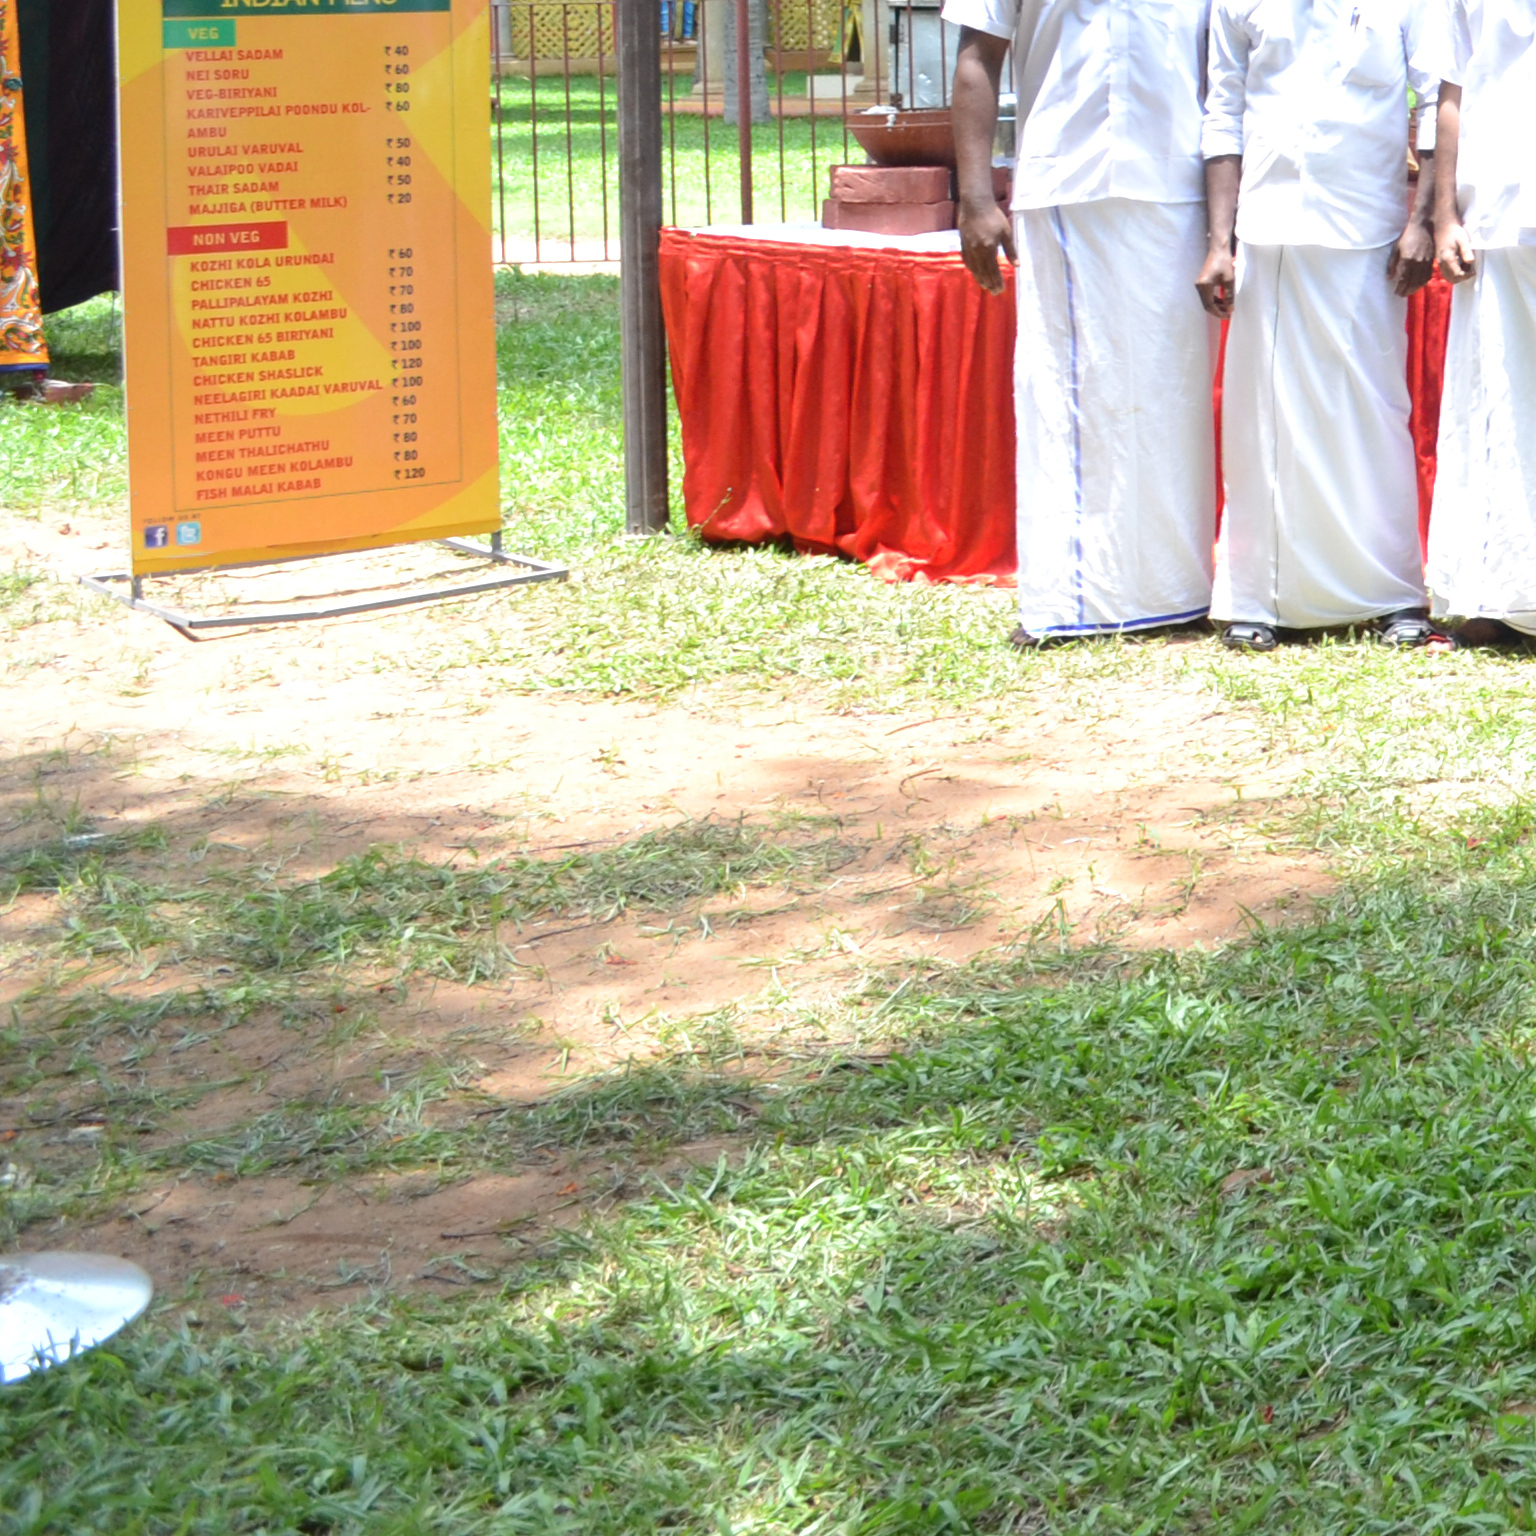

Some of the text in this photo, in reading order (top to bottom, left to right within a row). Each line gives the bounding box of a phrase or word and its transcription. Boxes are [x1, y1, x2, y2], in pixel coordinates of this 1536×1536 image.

[188, 27, 218, 39] VEG
[186, 49, 283, 62] VELLAI SADAM
[186, 69, 249, 81] NEI SORU
[187, 106, 281, 119] KARIVEPPILAI
[285, 104, 337, 115] POONDU
[187, 127, 226, 138] AMBU
[188, 143, 304, 158] URULAI VARUVAL
[188, 161, 298, 176] VALAIPOO VADAI
[188, 182, 278, 195] THAIR SADAM
[189, 196, 347, 215] MAJJIGA (BUTTER MILK)
[193, 231, 259, 245] NON VEG
[191, 253, 334, 272] KOZHI KOLA URUNDAI
[191, 278, 252, 291] CHICKEN
[192, 291, 332, 310] PALLIPALAYAM KOZHI
[192, 308, 347, 329] NATTU KOZHI KOLAMBU
[193, 335, 253, 348] CHICKEN
[277, 328, 333, 342] BIRIYANI
[192, 350, 295, 367] TANGIRI KABAB
[193, 366, 323, 386] CHICKEN SHASLICK
[194, 380, 383, 405] NEELAGIRI KAADAI VARUVAL
[195, 408, 275, 424] NETHILI FRY
[195, 426, 280, 443] MEEN PUTTU
[196, 440, 329, 462] MEEN THALICHATHU
[196, 456, 353, 481] KONGU MEEN KOLAMBU
[197, 478, 321, 500] FISH MALAI KABAB
